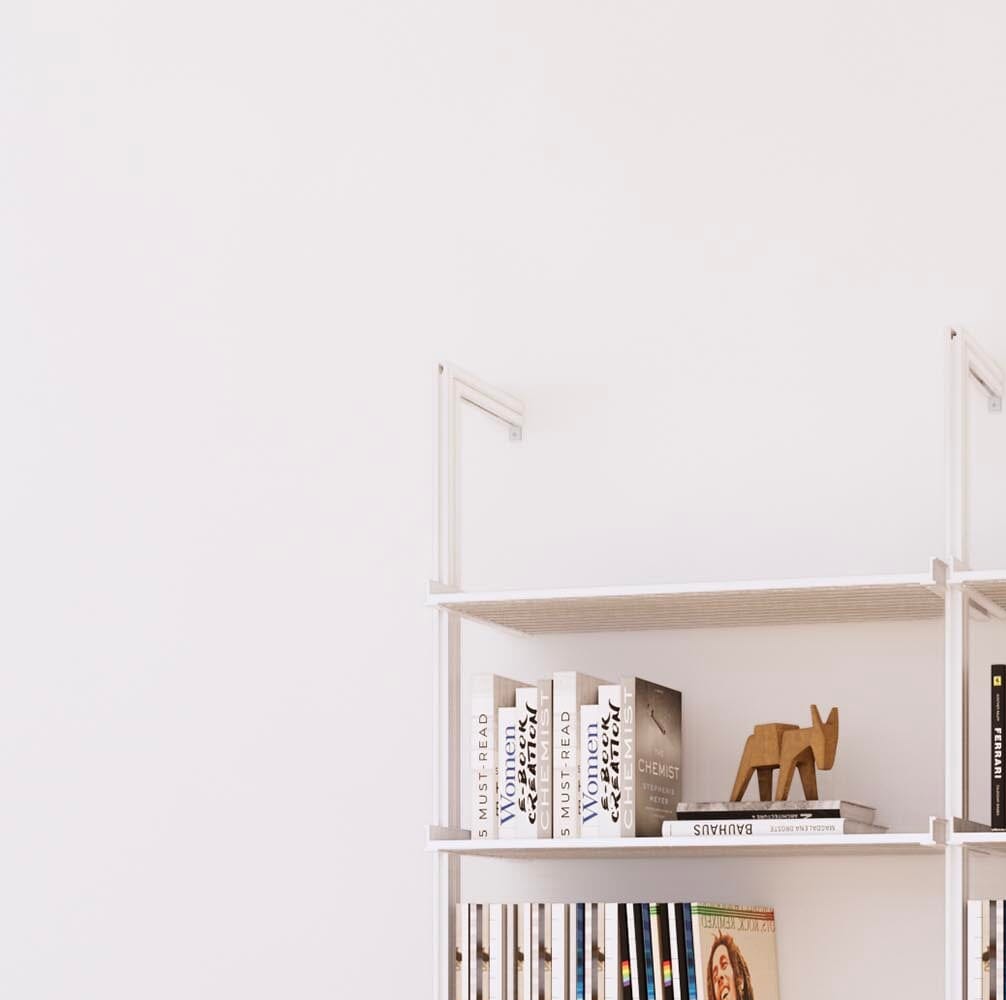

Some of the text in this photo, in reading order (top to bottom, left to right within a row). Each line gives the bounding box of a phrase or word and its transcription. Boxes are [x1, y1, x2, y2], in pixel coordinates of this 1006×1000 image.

[479, 714, 488, 820] MUST-READ
[500, 726, 516, 824] Women
[518, 715, 528, 812] E-BOOK
[526, 701, 538, 824] CREATION
[540, 690, 550, 830] CHEMIST
[561, 712, 570, 818] MUST-READ
[583, 723, 598, 824] Women
[601, 713, 611, 812] E-BOOK
[609, 698, 621, 824] CREATION
[624, 689, 632, 829] CHEMIST
[638, 758, 679, 781] CHEMIST
[994, 728, 1002, 778] FERRARI
[694, 823, 752, 835] BAUHAUS
